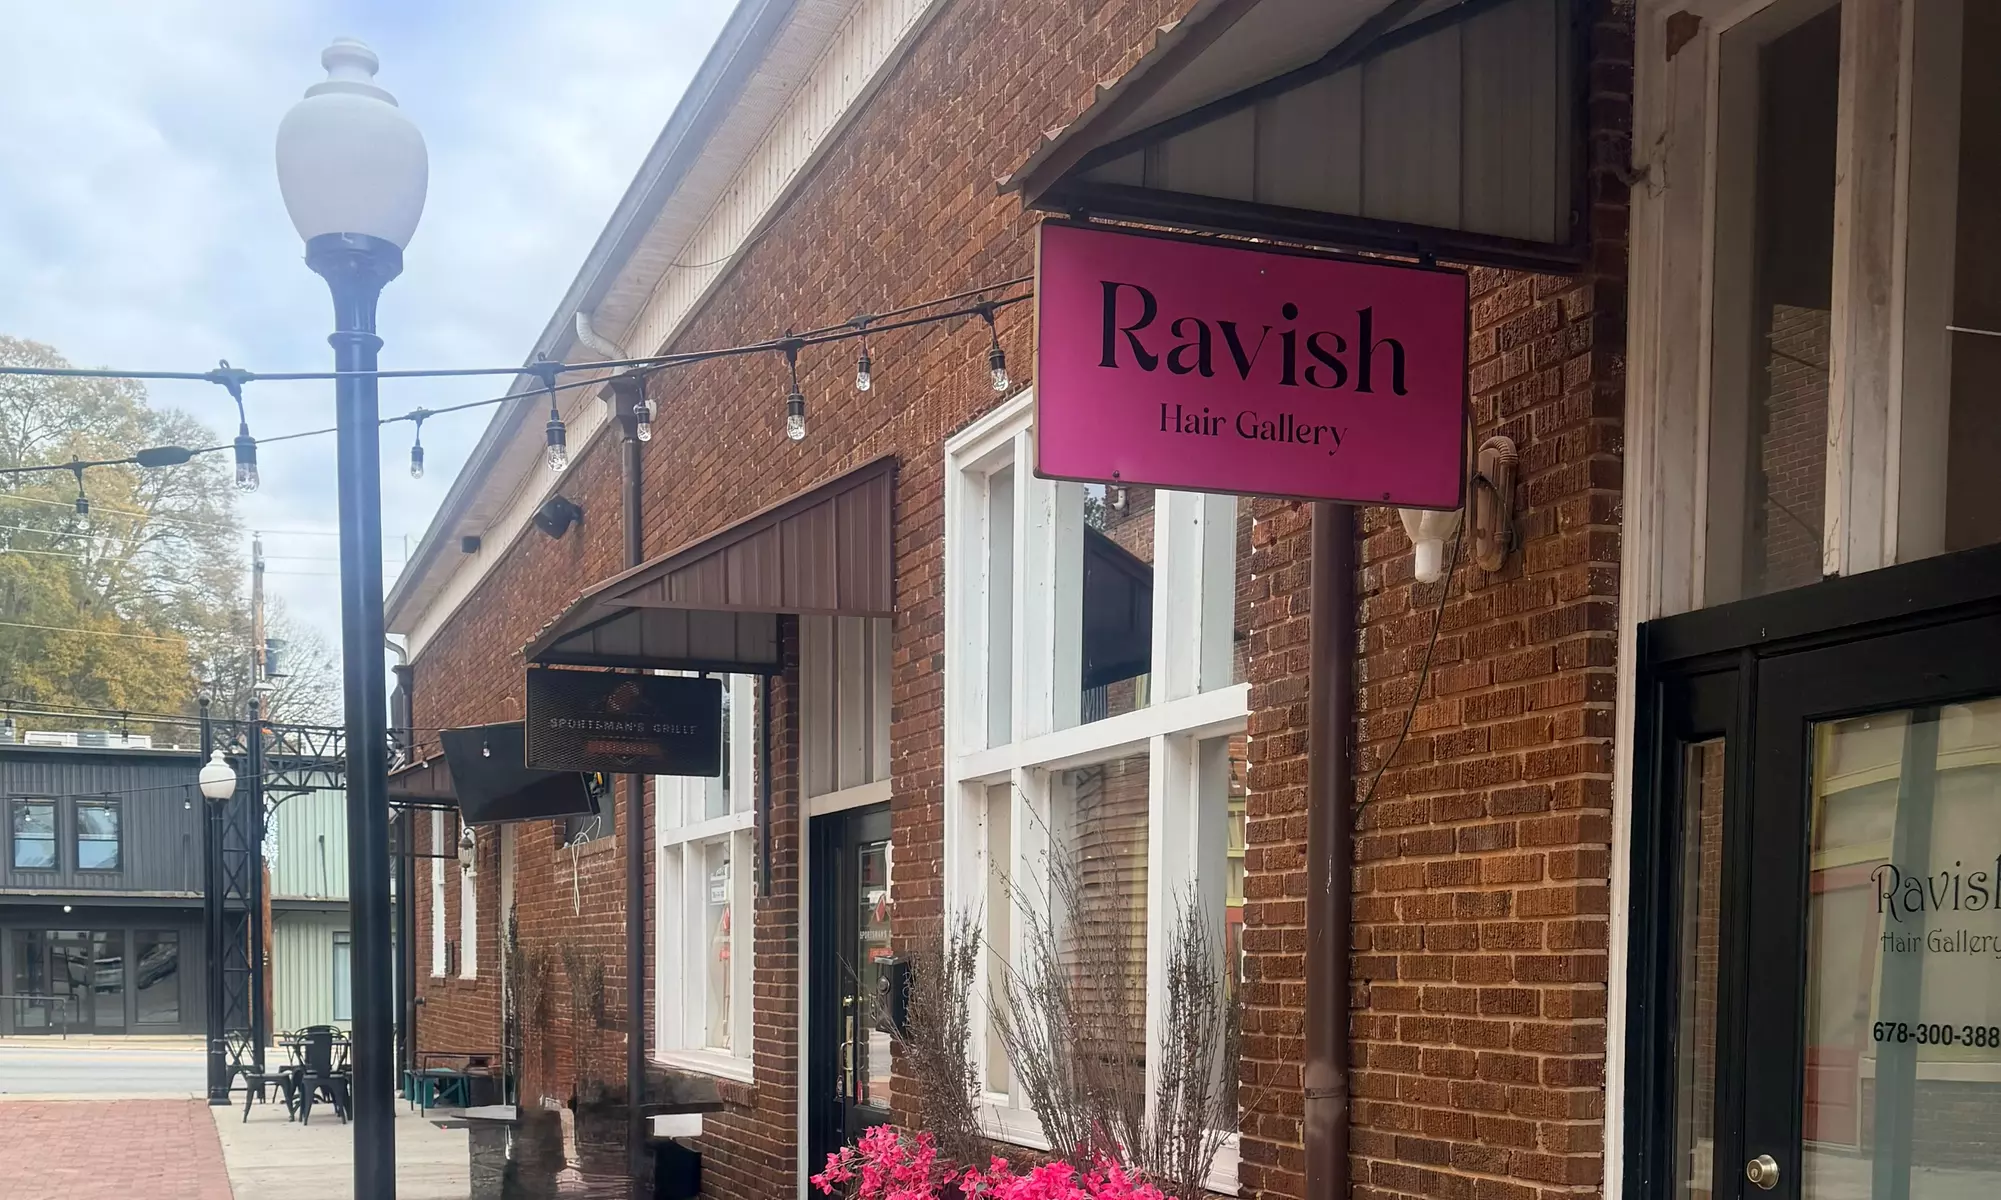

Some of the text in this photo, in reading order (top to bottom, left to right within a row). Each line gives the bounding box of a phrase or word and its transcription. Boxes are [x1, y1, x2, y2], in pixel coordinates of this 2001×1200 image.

[1097, 280, 1408, 396] Ravish
[1160, 402, 1348, 457] Hair Gallery
[549, 717, 699, 735] SPORTSMAN'S GRILLE
[1881, 931, 1922, 953] Hair
